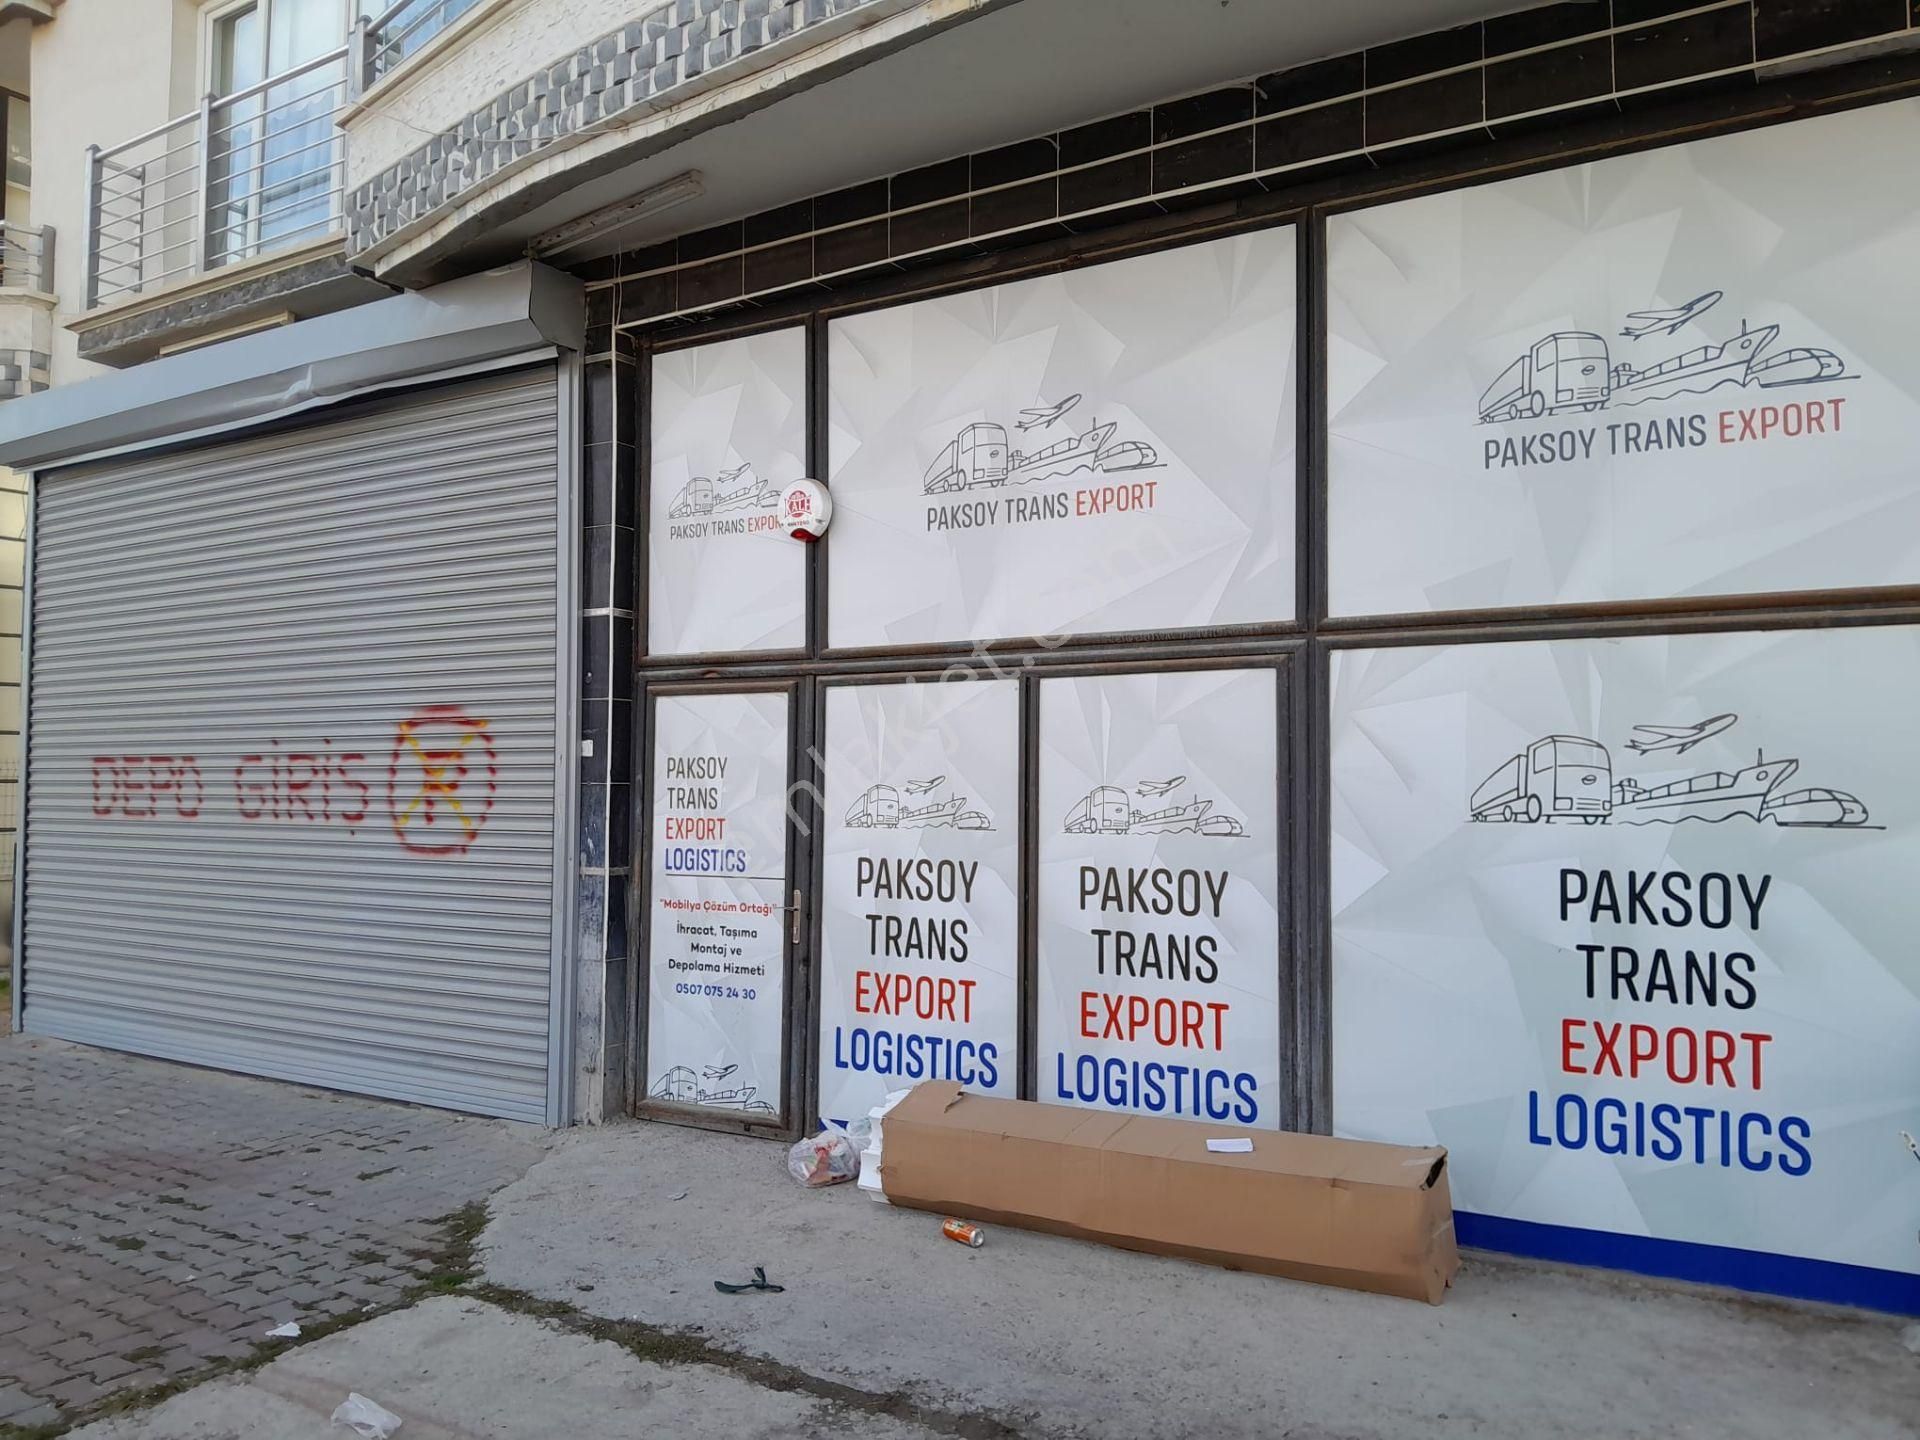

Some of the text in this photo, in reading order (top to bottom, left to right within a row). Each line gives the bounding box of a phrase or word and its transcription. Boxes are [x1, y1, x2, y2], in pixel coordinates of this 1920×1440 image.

[1483, 397, 1847, 470] PAKSOY TRANS EXPORT
[669, 521, 709, 541] PAKSOY
[711, 518, 745, 536] TRANS
[747, 513, 782, 533] EXPOR
[926, 481, 1158, 532] PAKSOY TRANS EXPORT
[92, 755, 204, 819] DEPO
[666, 756, 728, 780] PAKSOY
[667, 787, 719, 810] TRANS
[665, 817, 727, 841] EXPORT
[664, 847, 747, 873] LOGISTICS
[856, 856, 979, 904] PAKSOY
[703, 900, 738, 915] Çözüm
[1079, 865, 1229, 919] PAKSOY
[1558, 868, 1772, 931] PAKSOY
[690, 942, 743, 958] Montaj ve
[719, 925, 759, 941] Taşıma
[865, 914, 969, 964] TRANS
[1091, 928, 1219, 984] TRANS
[668, 958, 766, 977] Depolama Hizmeti
[675, 983, 757, 1001] 0507 075 24 30
[1575, 944, 1757, 1010] TRANS
[855, 970, 977, 1024] EXPORT
[1080, 991, 1230, 1052] EXPORT
[835, 1026, 998, 1089] LOGISTICS
[1561, 1018, 1773, 1091] EXPORT
[1057, 1052, 1259, 1124] LOGISTICS
[1528, 1090, 1812, 1177] LOGISTICS
